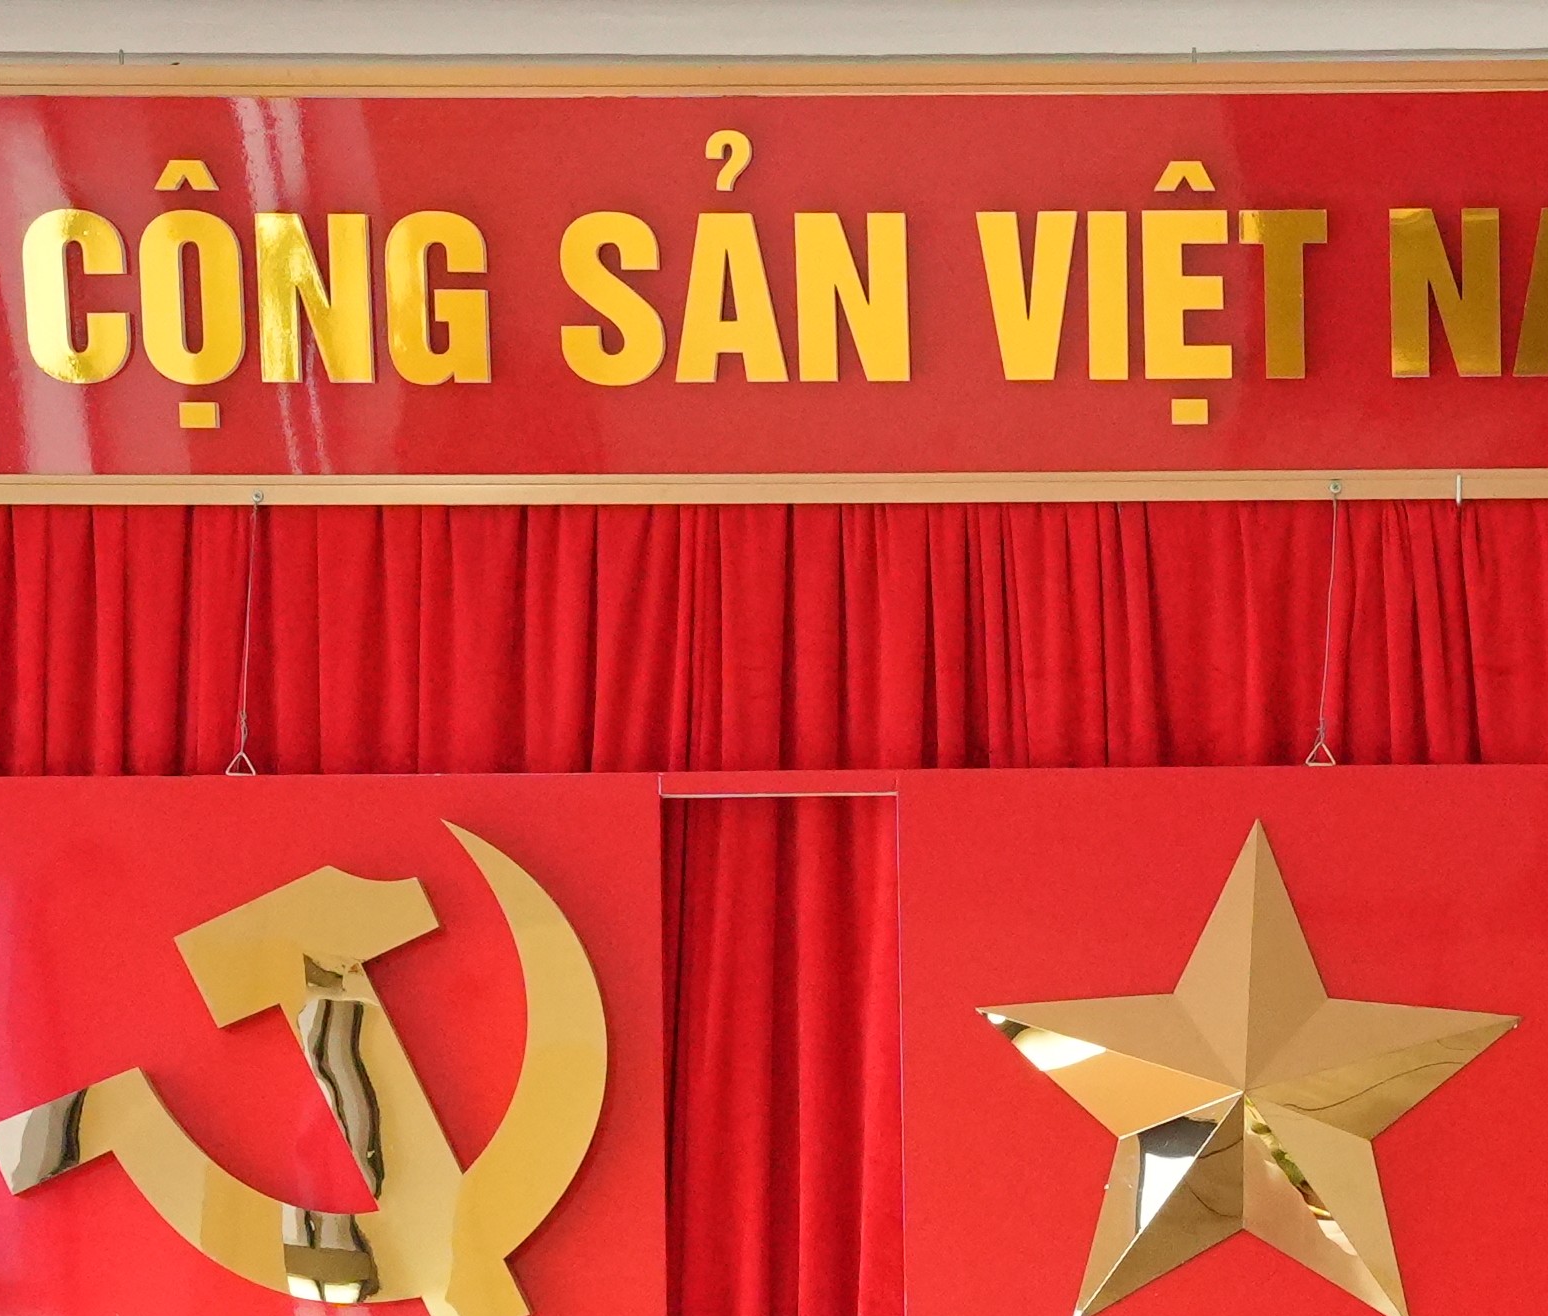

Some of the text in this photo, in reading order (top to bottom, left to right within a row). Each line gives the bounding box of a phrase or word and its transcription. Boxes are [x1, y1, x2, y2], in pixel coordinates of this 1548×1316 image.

[22, 158, 490, 428] CỘNG
[560, 130, 910, 386] SẢN
[976, 161, 1327, 426] VIỆT
